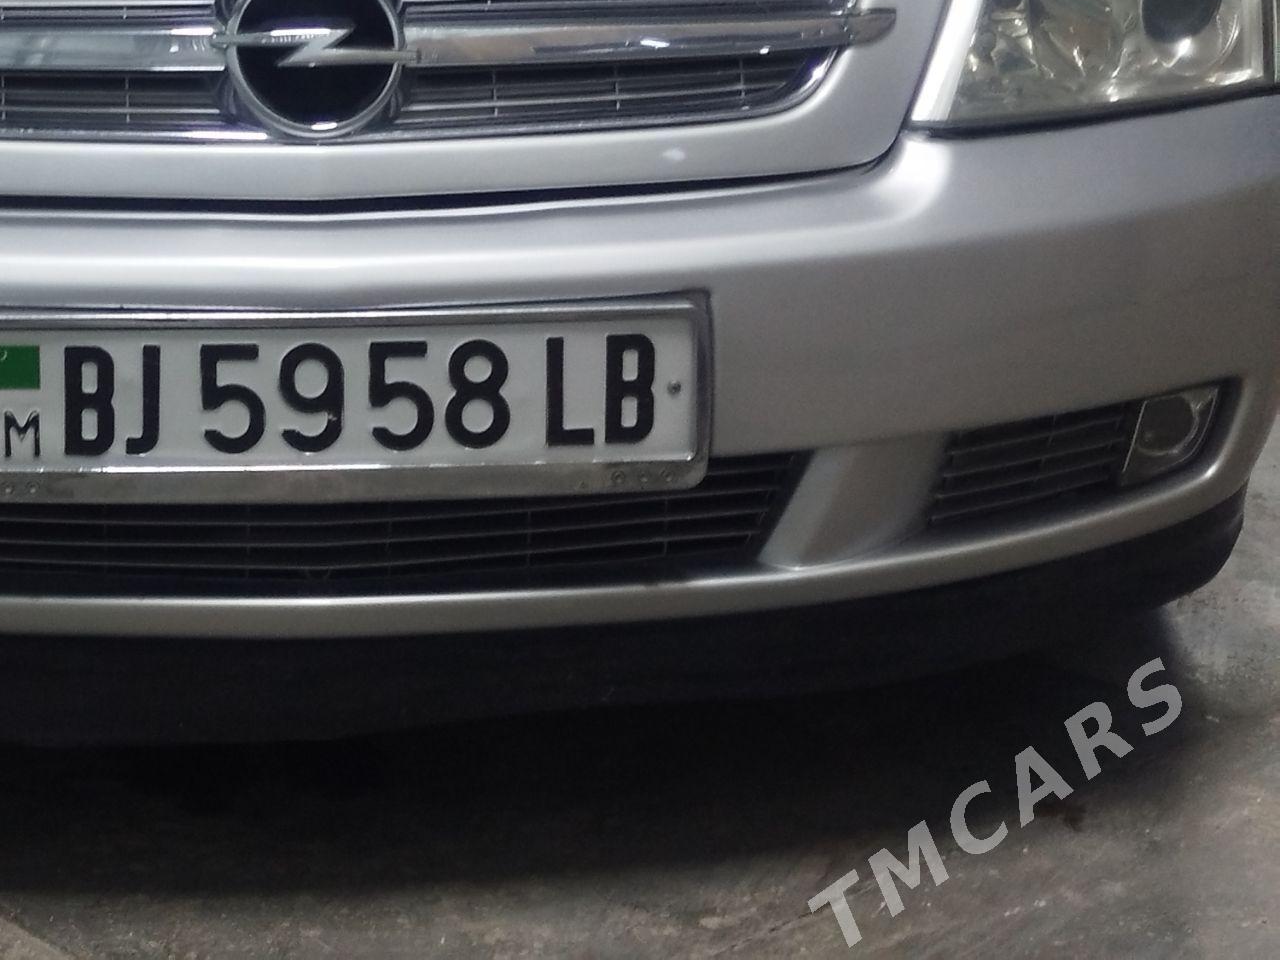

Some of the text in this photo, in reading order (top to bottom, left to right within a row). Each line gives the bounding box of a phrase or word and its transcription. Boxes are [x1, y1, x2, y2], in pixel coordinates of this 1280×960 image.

[63, 334, 655, 456] BJ 5958 LB
